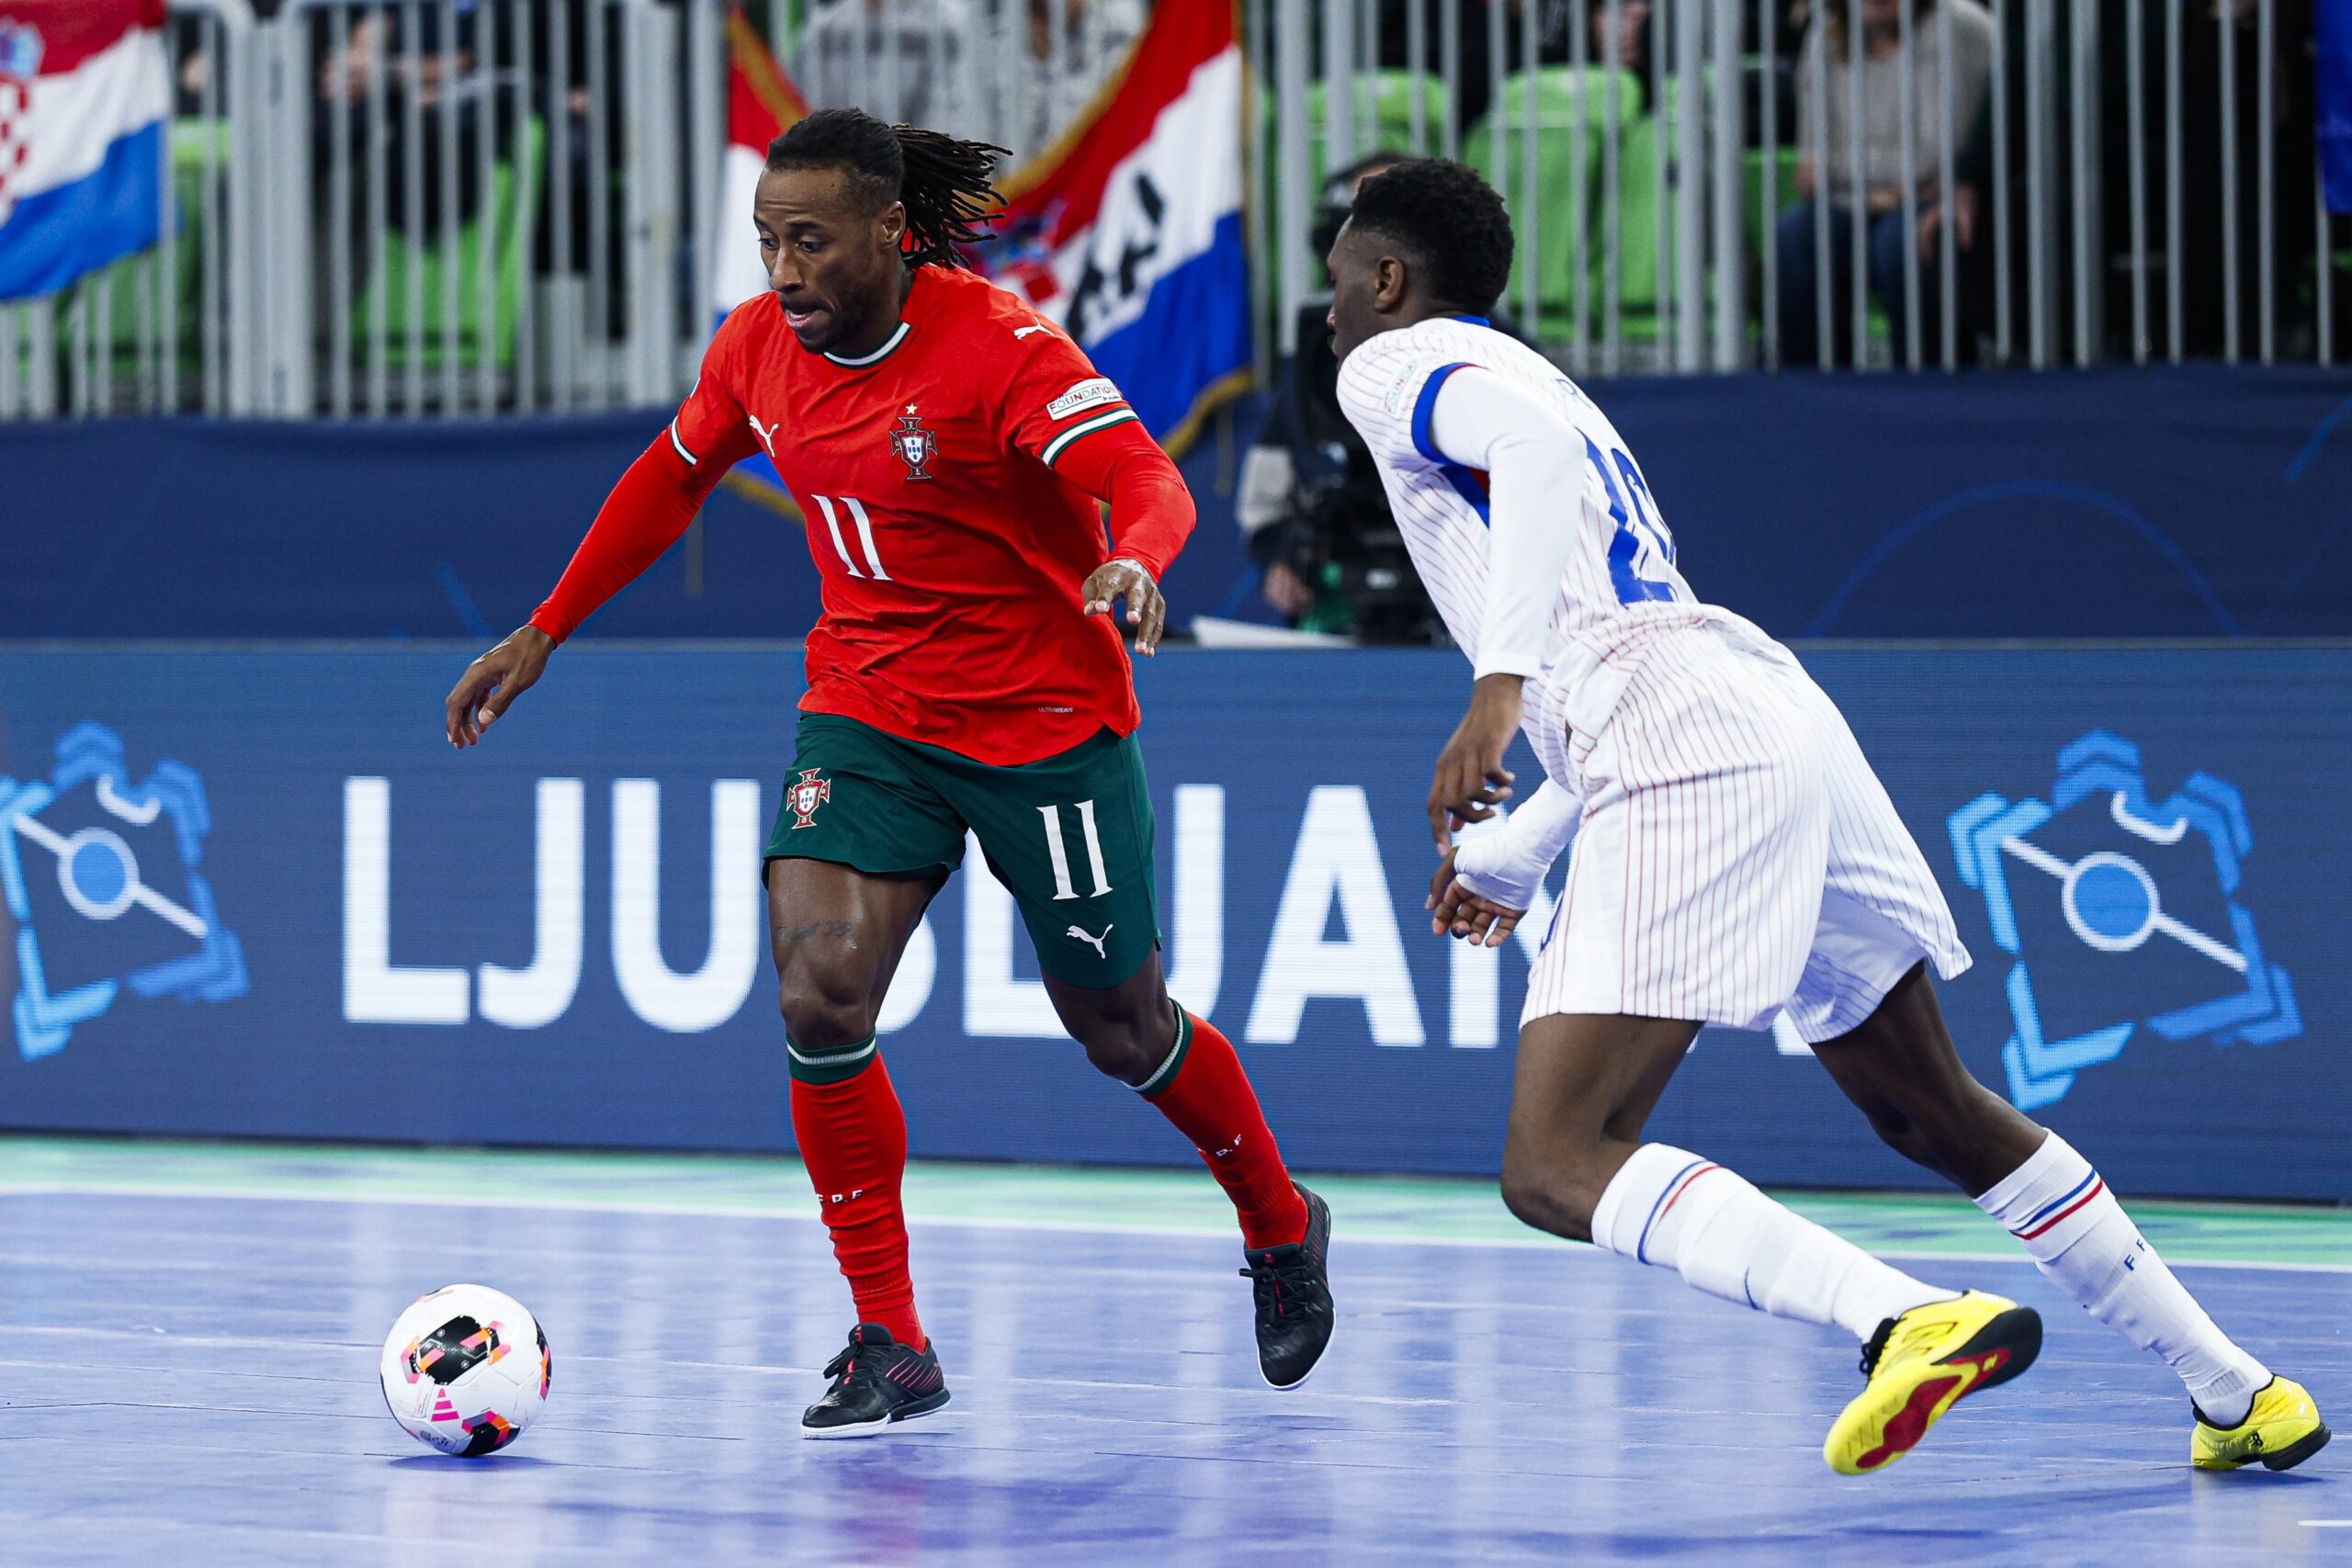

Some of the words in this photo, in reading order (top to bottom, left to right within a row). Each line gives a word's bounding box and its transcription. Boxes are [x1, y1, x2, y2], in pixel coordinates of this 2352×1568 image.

[1049, 385, 1115, 412] FOUNDATION
[810, 493, 894, 581] 11
[1035, 799, 1114, 900] 11
